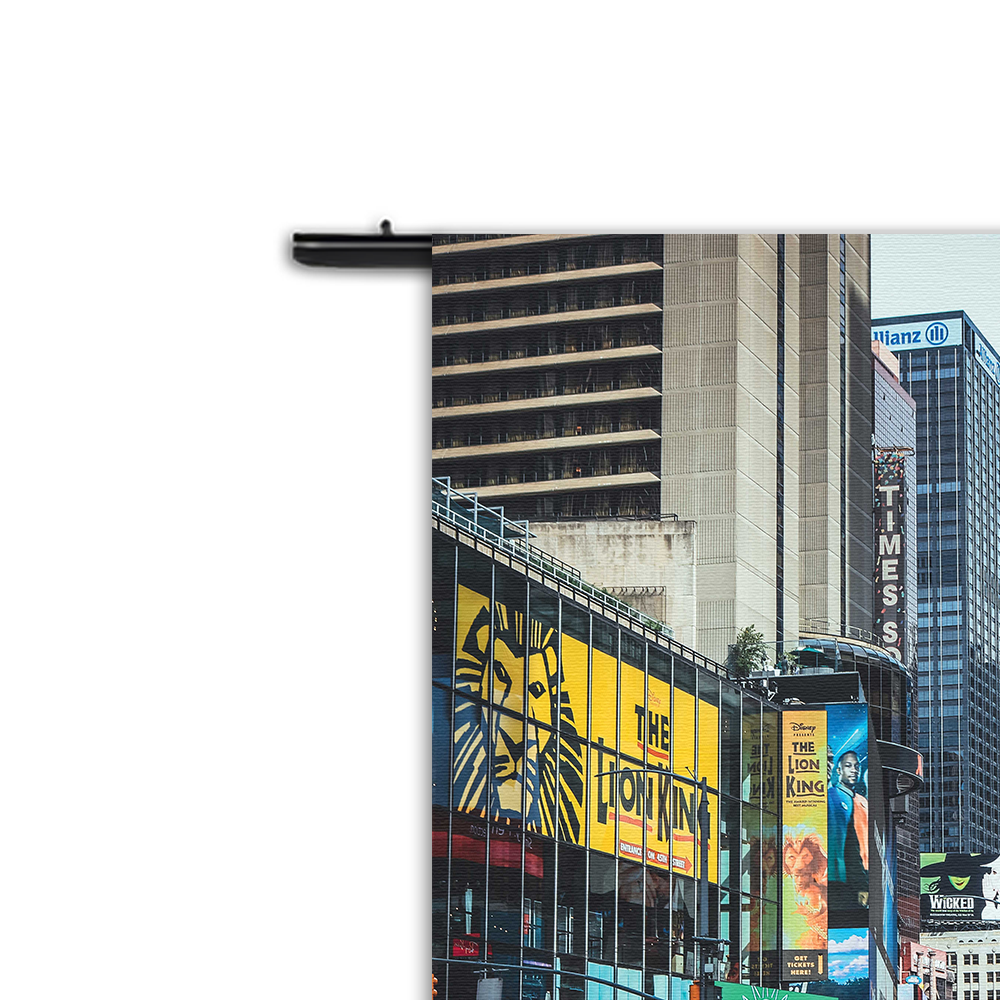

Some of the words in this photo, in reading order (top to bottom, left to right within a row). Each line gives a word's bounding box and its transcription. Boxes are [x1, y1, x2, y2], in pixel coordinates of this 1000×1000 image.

[879, 485, 901, 607] TIMES
[635, 704, 669, 751] THE
[789, 722, 816, 733] Disney
[792, 742, 815, 752] THE
[788, 755, 820, 774] LION
[598, 737, 653, 824] LION
[786, 775, 825, 798] KING
